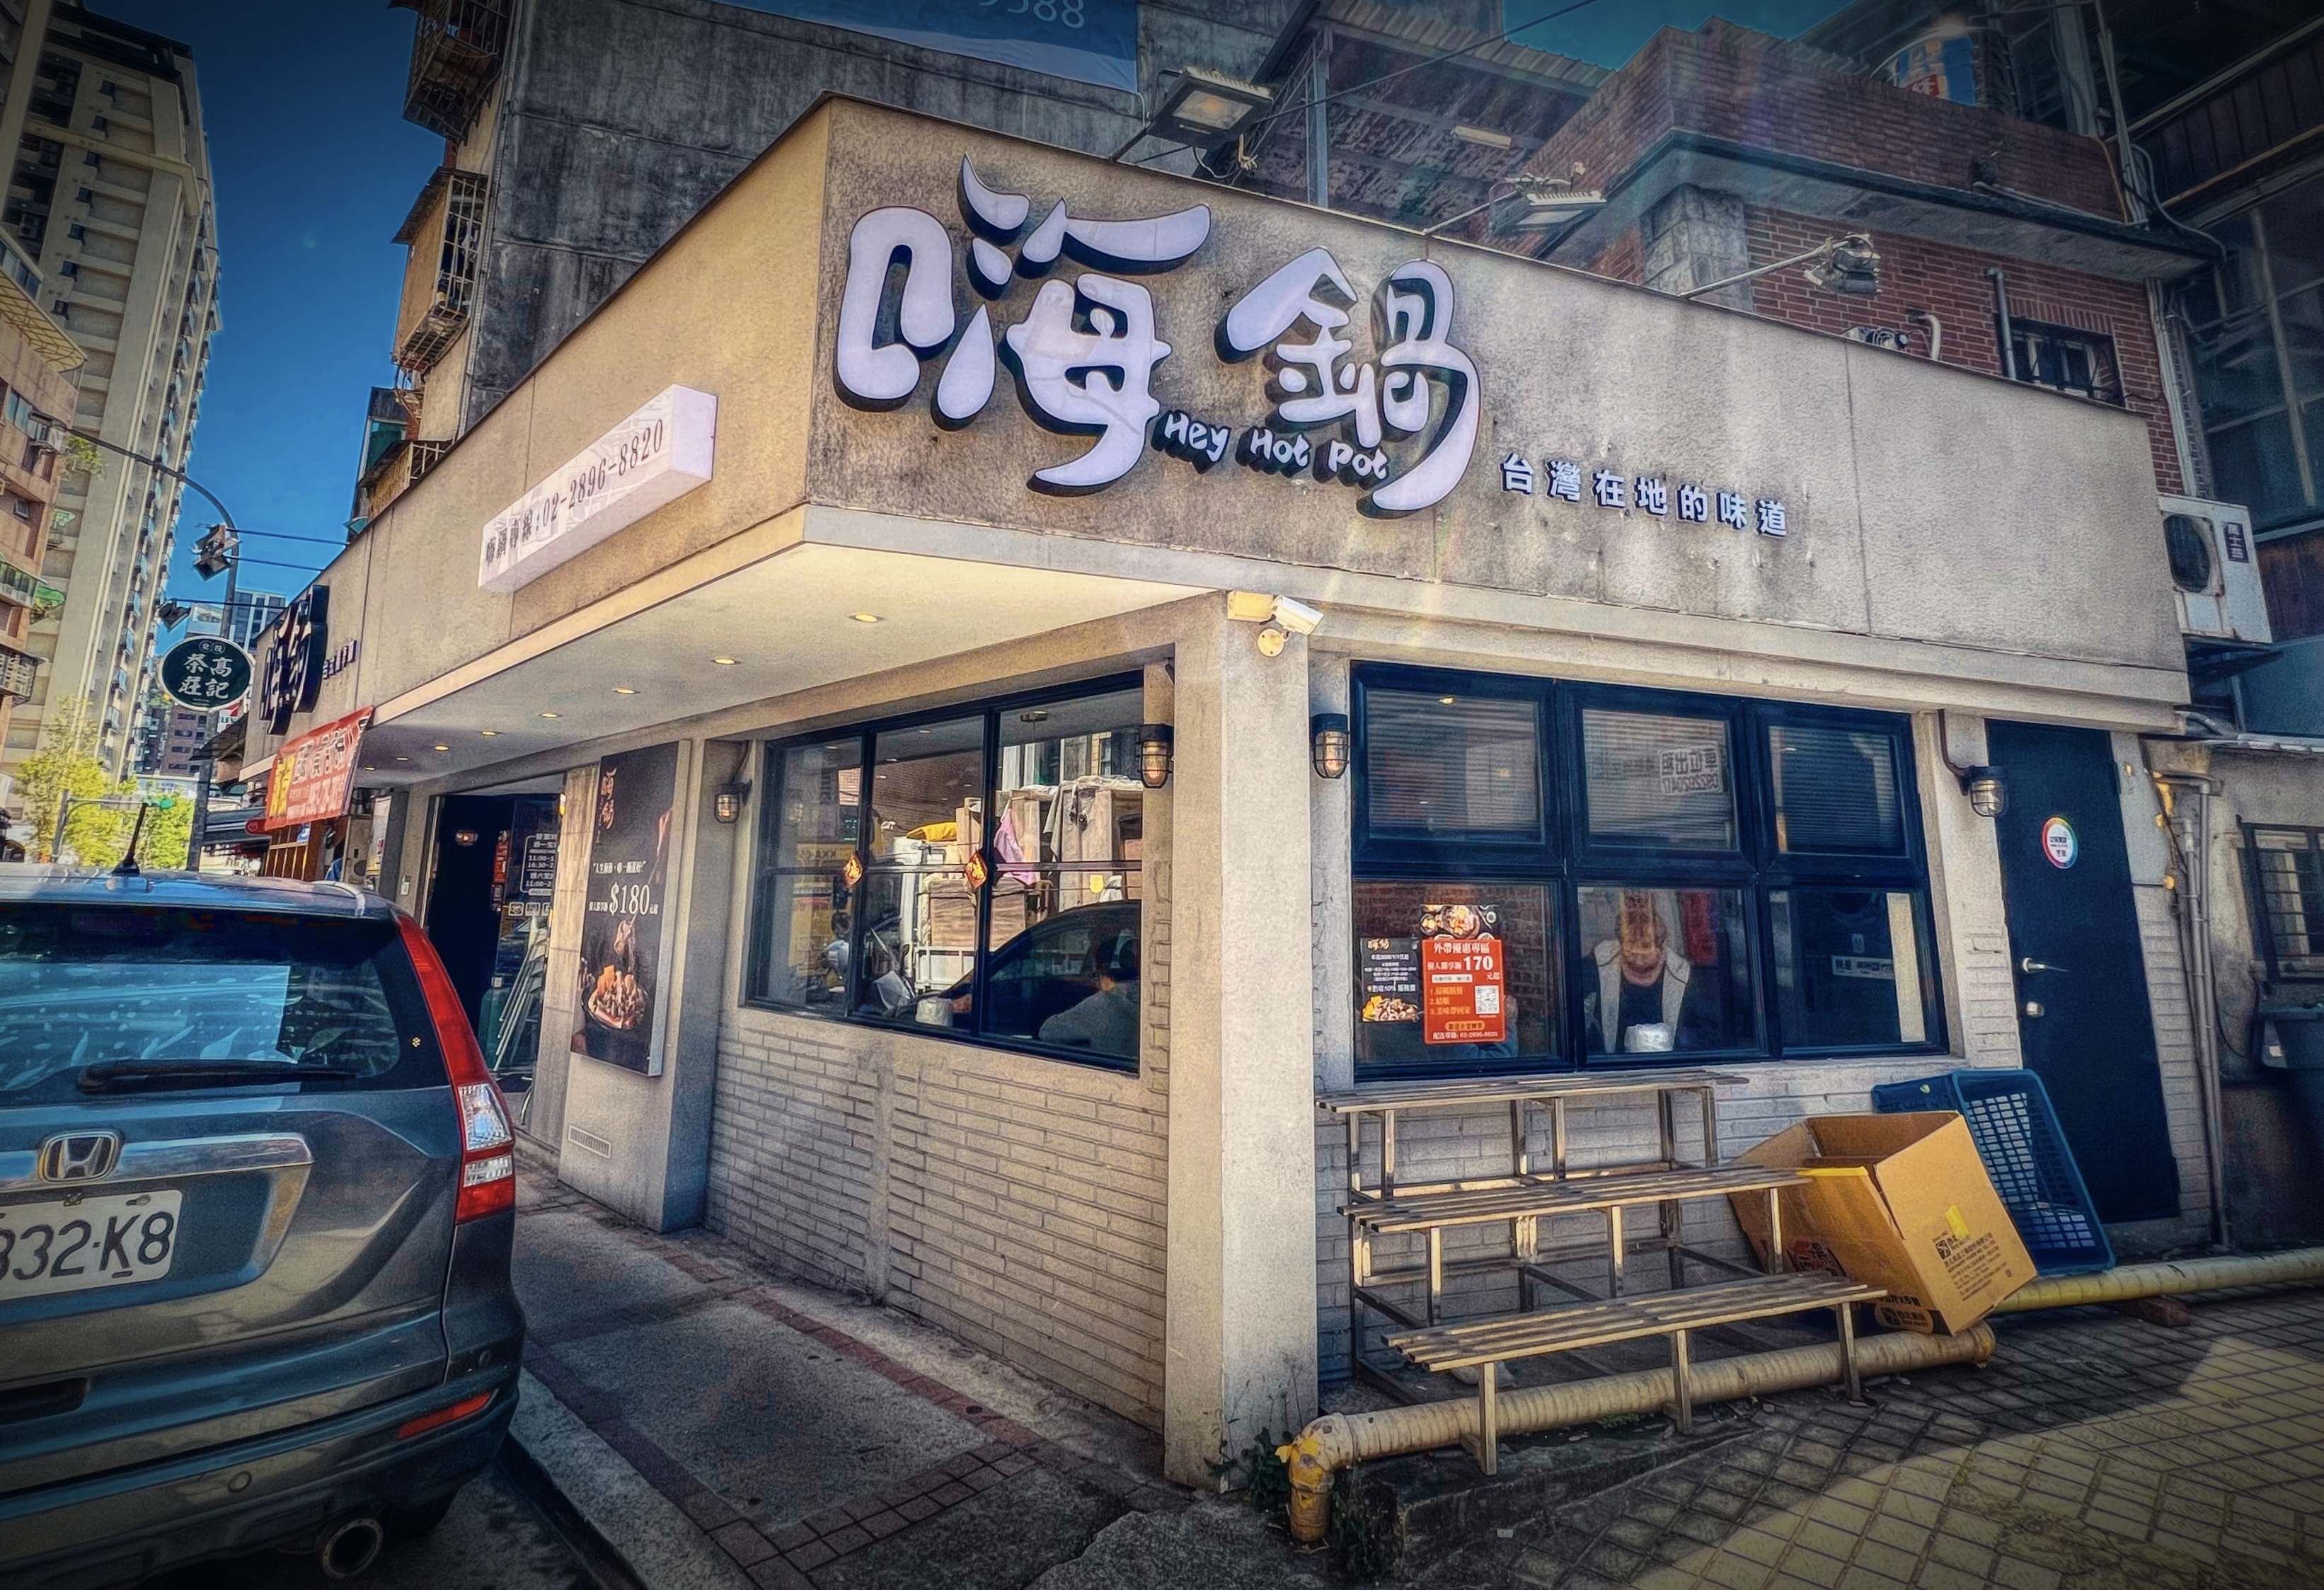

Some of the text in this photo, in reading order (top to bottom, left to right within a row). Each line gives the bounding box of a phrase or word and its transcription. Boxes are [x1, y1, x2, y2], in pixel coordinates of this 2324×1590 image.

[979, 0, 1085, 28] 88
[835, 153, 1480, 515] 嗨鍋
[1162, 412, 1231, 463] Hey
[1249, 427, 1311, 467] Hot
[1500, 453, 1787, 537] 台灣在地的味道
[609, 882, 650, 916] $180
[1434, 942, 1490, 954] 外帶優惠專區
[1463, 955, 1493, 971] 170
